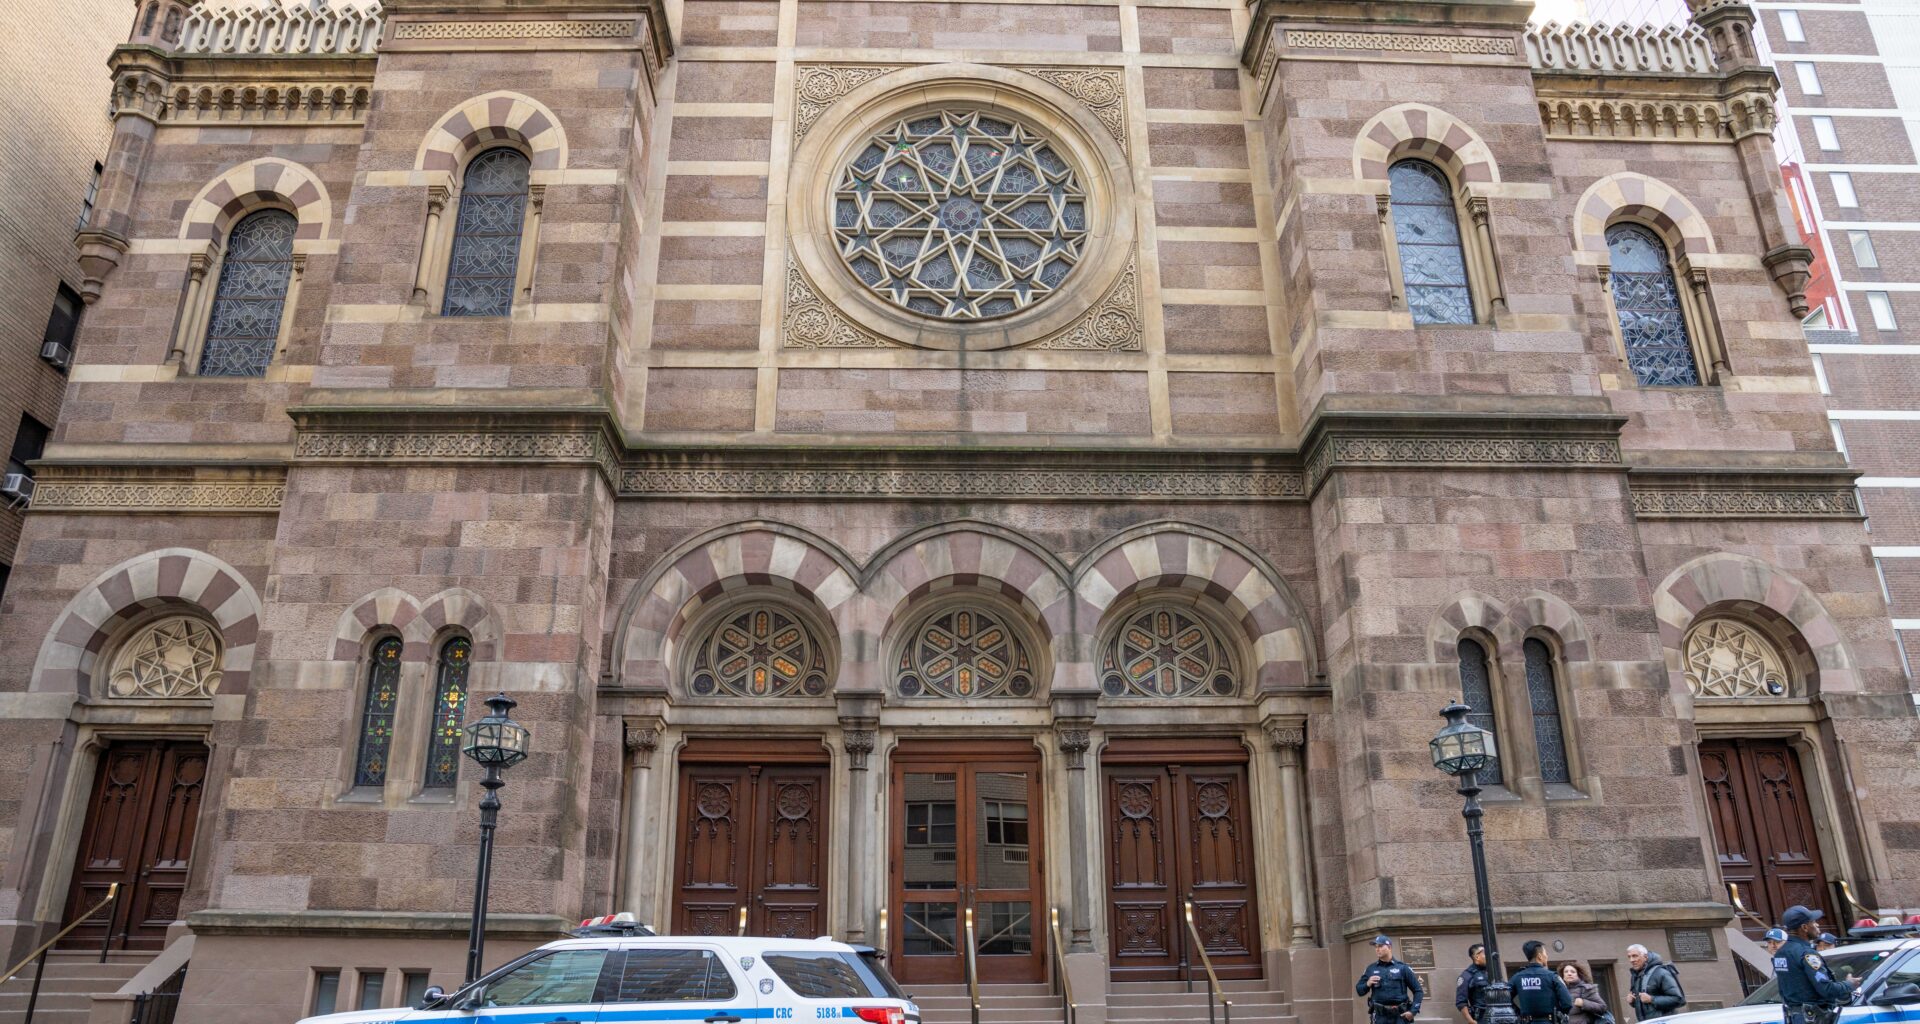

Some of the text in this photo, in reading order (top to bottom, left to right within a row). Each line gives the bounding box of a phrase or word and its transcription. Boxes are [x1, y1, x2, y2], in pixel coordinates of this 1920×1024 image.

[1521, 977, 1542, 987] NYPD
[775, 1007, 793, 1019] CRC
[816, 1007, 837, 1019] 5188
